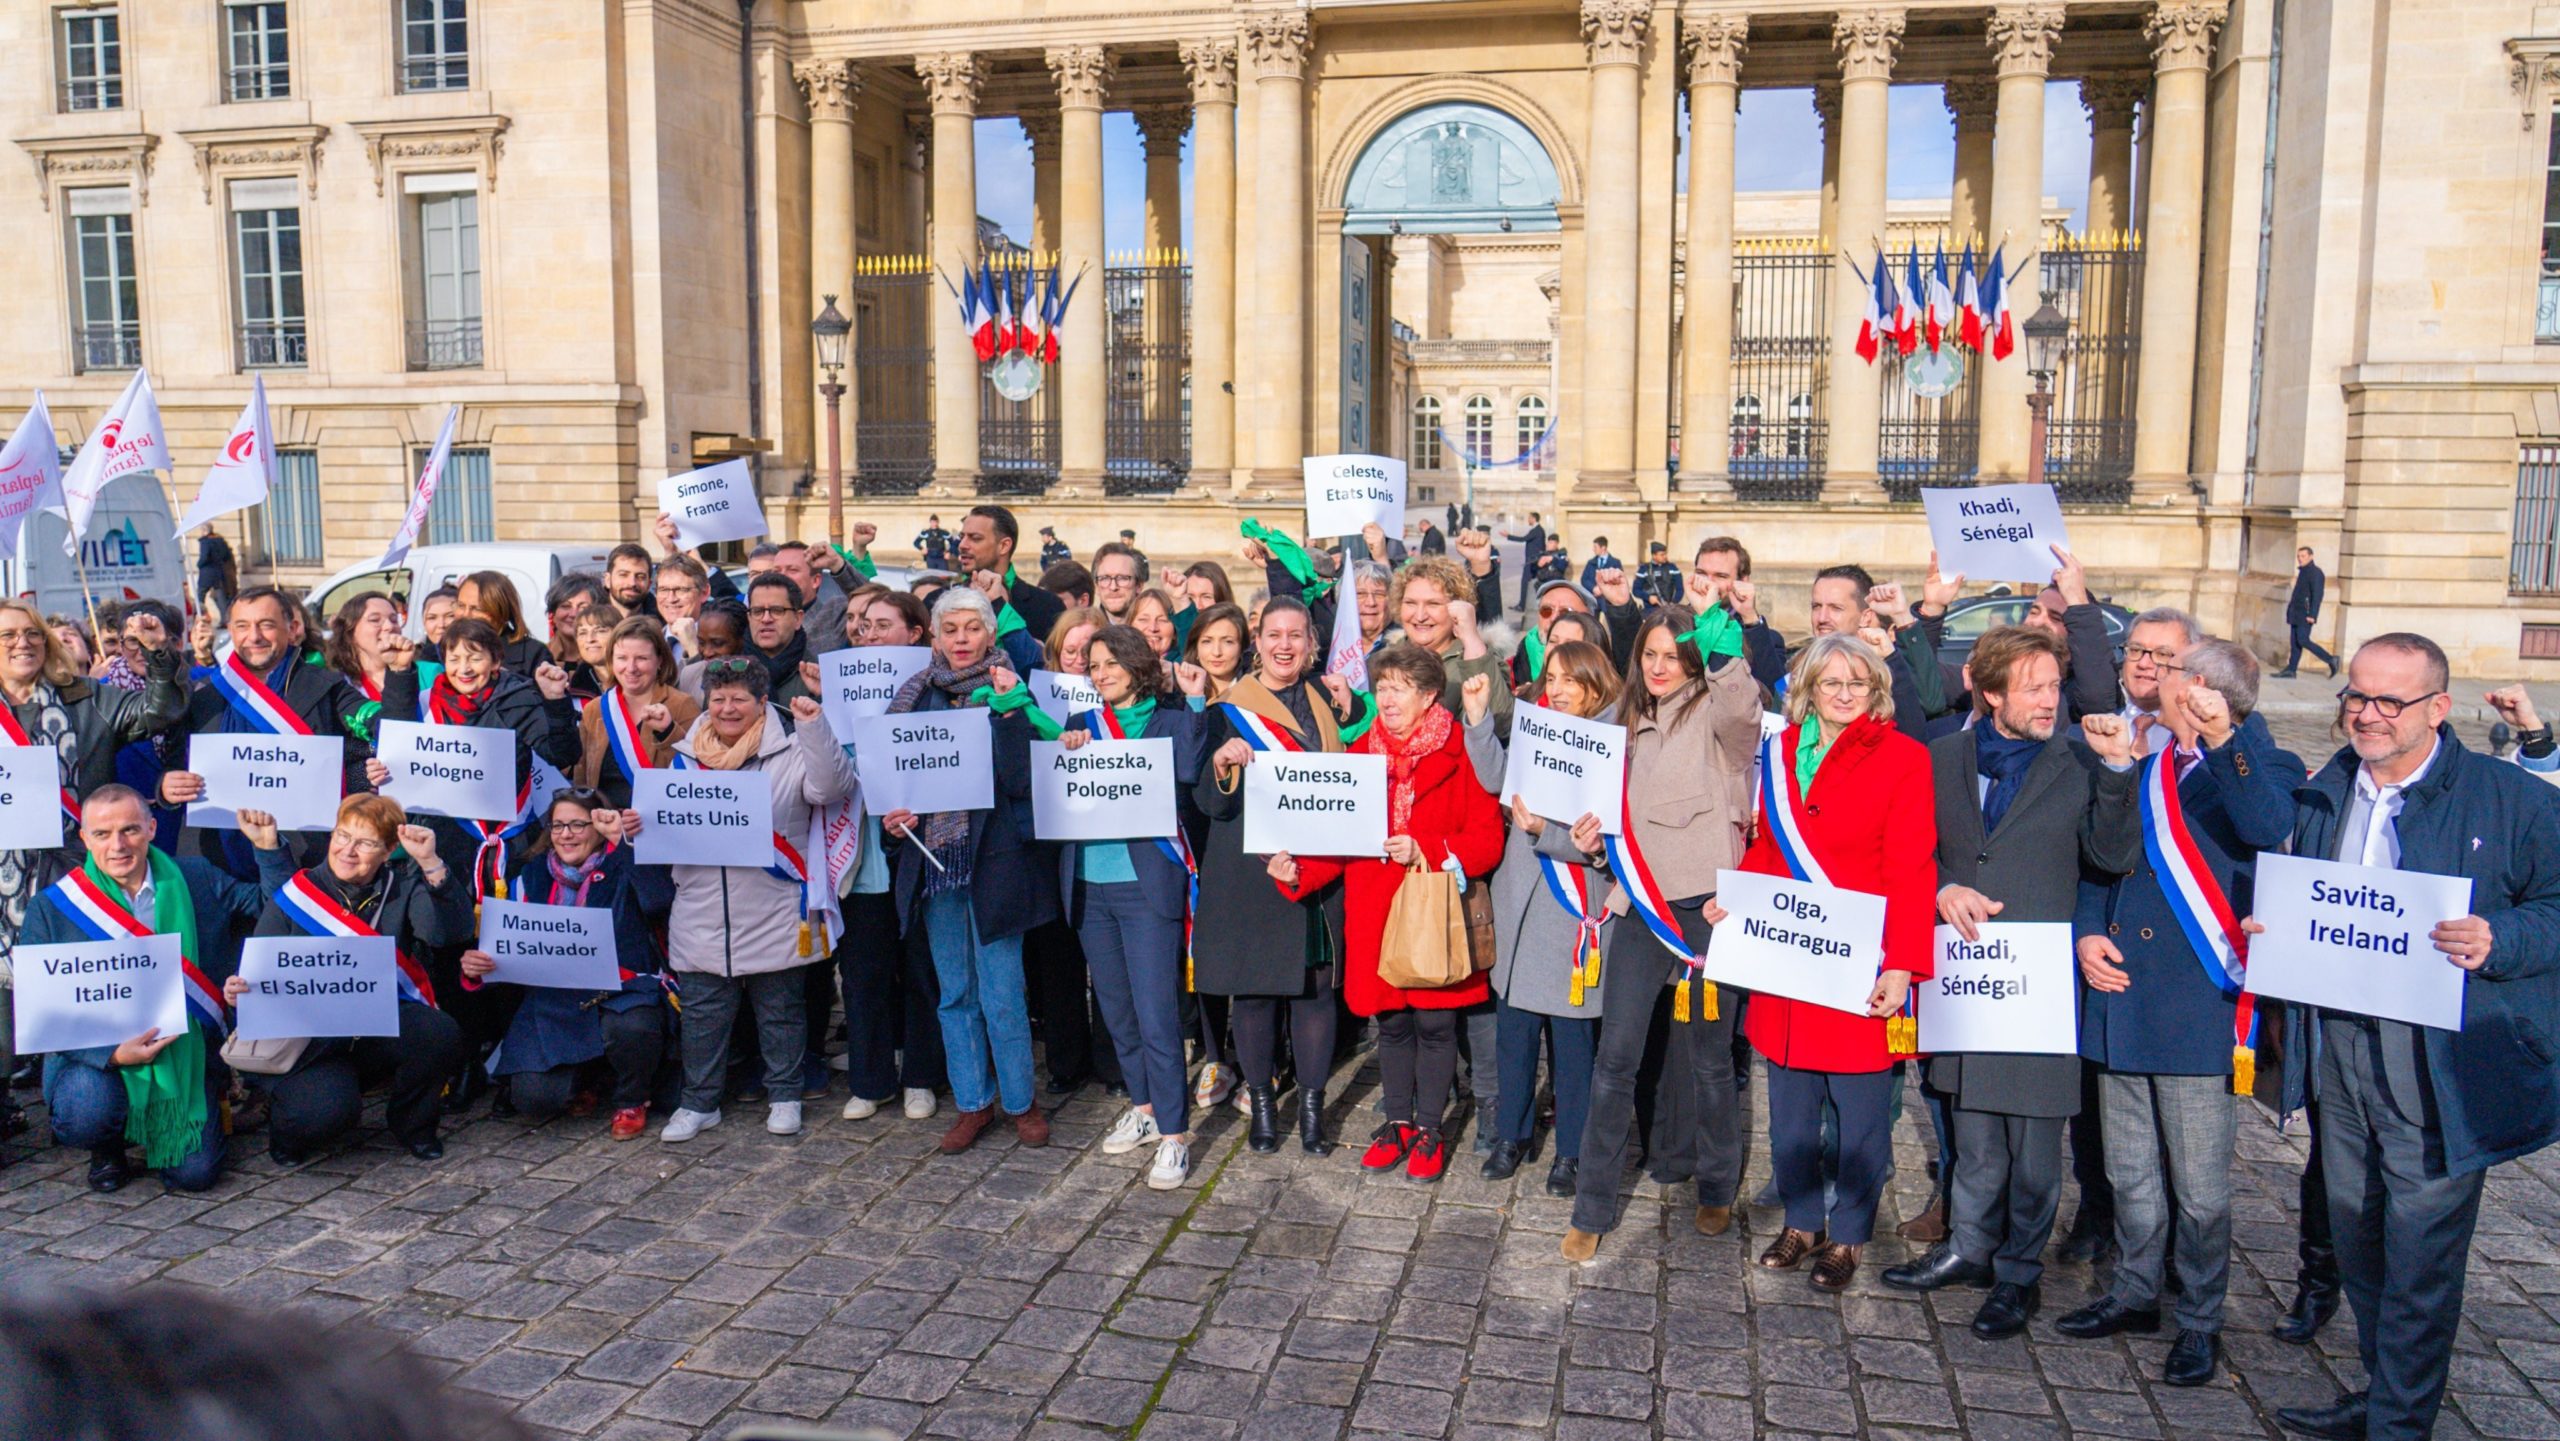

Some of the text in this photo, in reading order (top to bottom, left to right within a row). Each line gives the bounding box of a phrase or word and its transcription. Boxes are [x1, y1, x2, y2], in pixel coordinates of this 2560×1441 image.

[1332, 464, 1388, 483] Celeste,
[677, 478, 729, 499] Simone,
[1326, 487, 1394, 504] Etats Unis
[685, 499, 731, 519] France
[1959, 497, 2020, 517] Khadi,
[1960, 522, 2034, 543] Sénégal
[839, 658, 898, 678] Izabela,
[842, 683, 894, 703] Poland
[1050, 684, 1104, 704] Valent
[892, 725, 955, 744] Savita,
[1519, 715, 1612, 759] Marie-Claire,
[232, 746, 305, 766] Masha,
[416, 736, 478, 758] Marta,
[895, 750, 960, 771] Ireland
[1053, 752, 1153, 774] Agnieszka,
[1534, 750, 1583, 778] France
[248, 772, 287, 789] Iran
[410, 761, 485, 783] Pologne
[1274, 765, 1358, 787] Vanessa,
[665, 782, 739, 803] Celeste,
[1066, 780, 1143, 801] Pologne
[1277, 794, 1356, 812] Andorre
[657, 810, 749, 827] Etats Unis
[1773, 892, 1828, 923] Olga,
[2311, 879, 2405, 918] Savita,
[502, 913, 588, 937] Manuela,
[496, 939, 598, 957] El Salvador
[1743, 917, 1852, 958] Nicaragua
[2309, 919, 2409, 956] Ireland
[277, 949, 358, 969] Beatriz,
[1946, 939, 2017, 963] Khadi,
[43, 953, 158, 976] Valentina,
[76, 982, 133, 1003] Italie
[260, 976, 378, 996] El Salvador
[1941, 974, 2027, 1000] Sénégal
